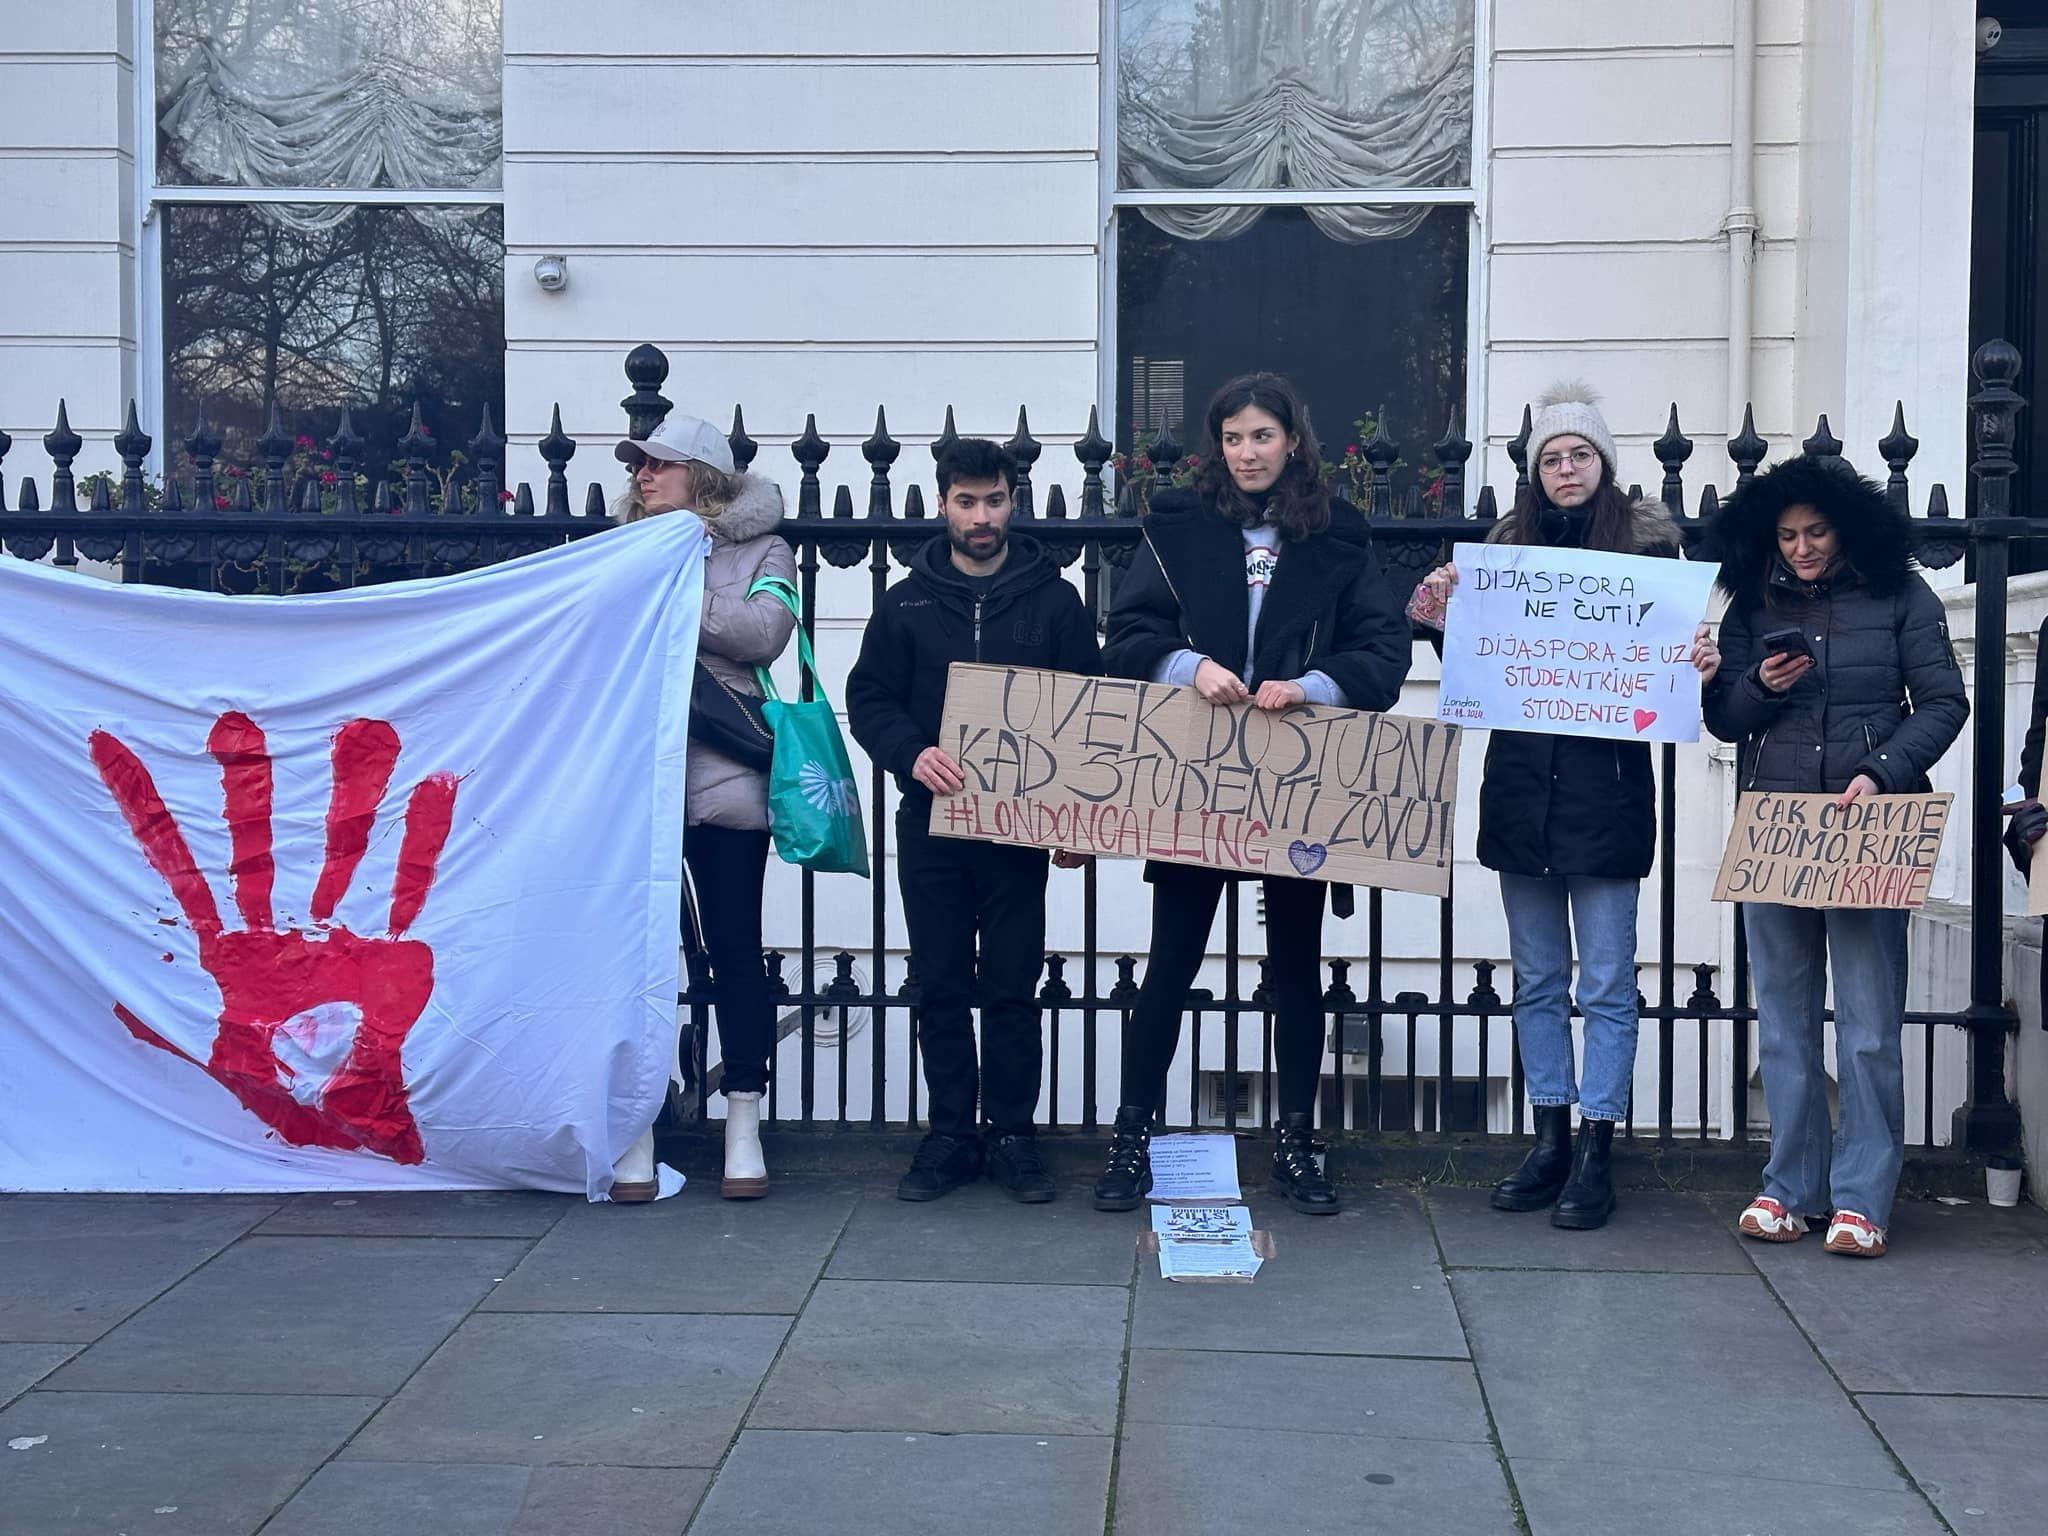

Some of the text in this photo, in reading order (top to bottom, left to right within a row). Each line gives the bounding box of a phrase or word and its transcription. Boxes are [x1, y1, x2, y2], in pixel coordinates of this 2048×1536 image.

[1474, 567, 1635, 598] DIJASPORA
[1524, 599, 1559, 618] NE
[1475, 633, 1694, 665] DIJASPORA JE UZ
[1443, 694, 1481, 708] London
[1522, 698, 1630, 724] STUDENTE
[1002, 667, 1459, 803] UVEK DOSTUPNI
[959, 724, 1451, 868] KAD STUDENTI ZOVU!
[1755, 792, 1948, 834] ČAK ODAVDE
[943, 792, 1270, 872] #LONDONCALLING
[1856, 832, 1940, 868] RUKE
[1727, 858, 1931, 906] SU VAM KRVAVE
